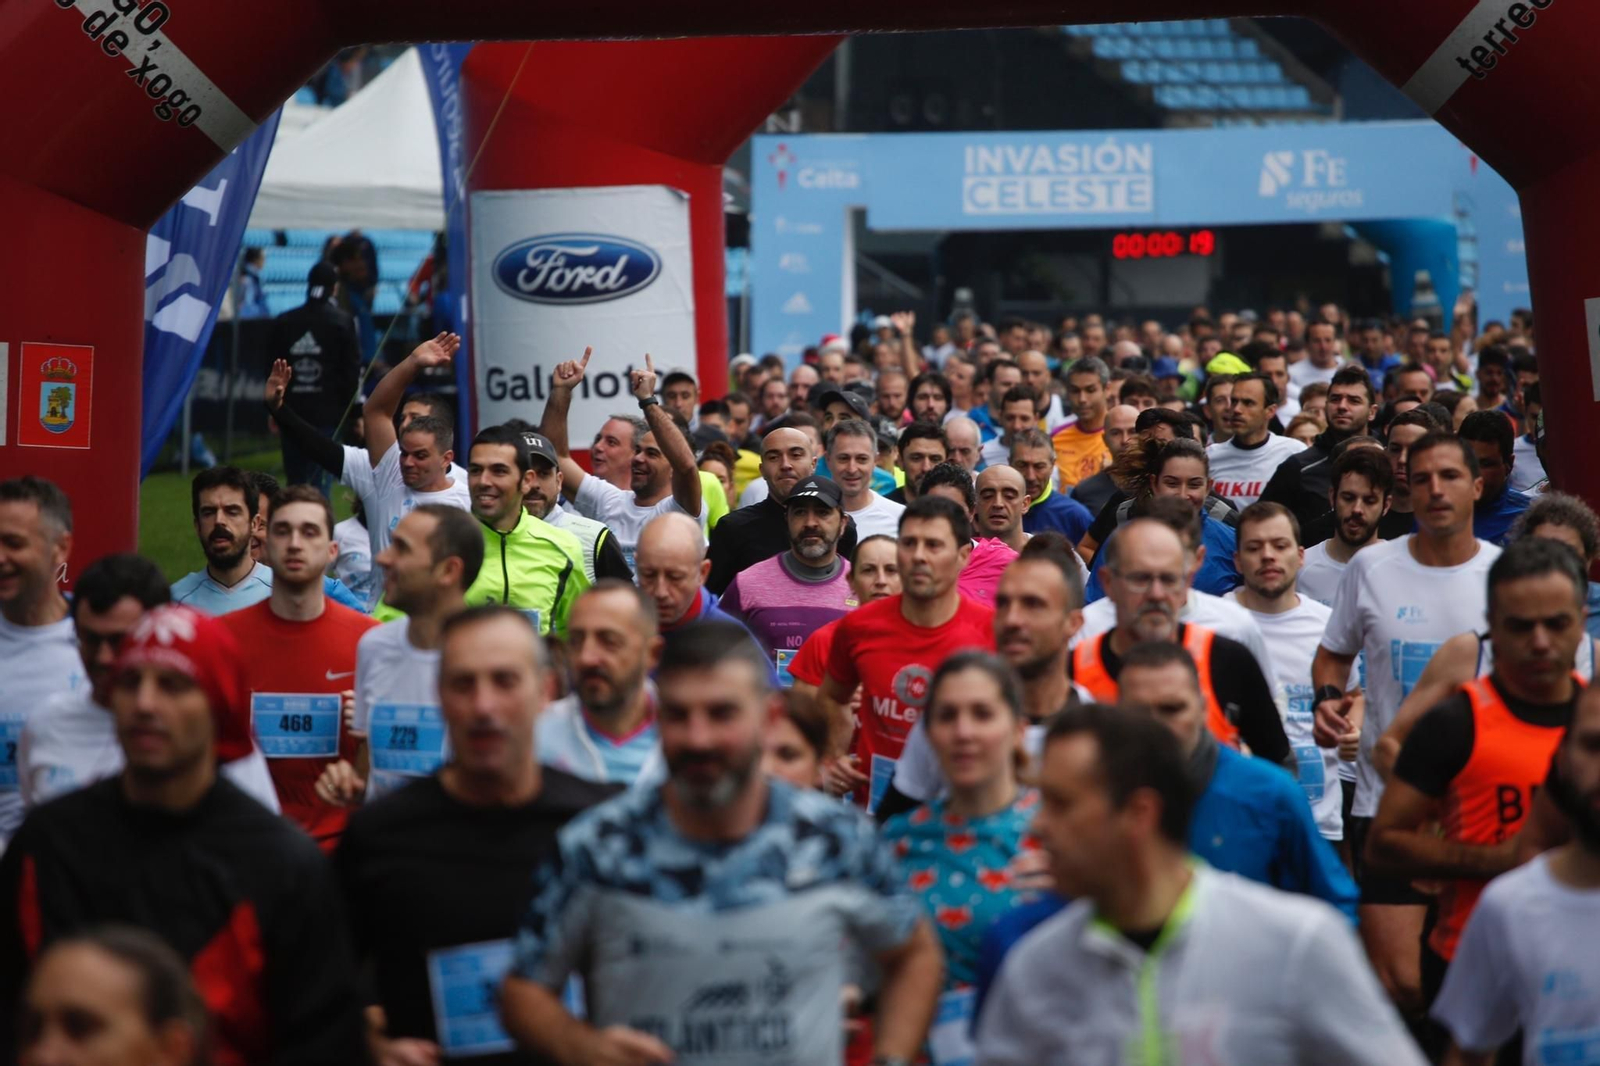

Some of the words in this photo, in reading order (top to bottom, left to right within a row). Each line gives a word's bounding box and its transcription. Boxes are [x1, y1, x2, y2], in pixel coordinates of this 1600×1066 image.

[82, 10, 130, 57] de
[125, 54, 203, 128] xogo
[964, 137, 1153, 174] INVASIÓN
[967, 178, 1149, 210] CELESTE
[516, 244, 630, 293] Ford
[279, 713, 313, 732] 468
[872, 694, 922, 723] MLe
